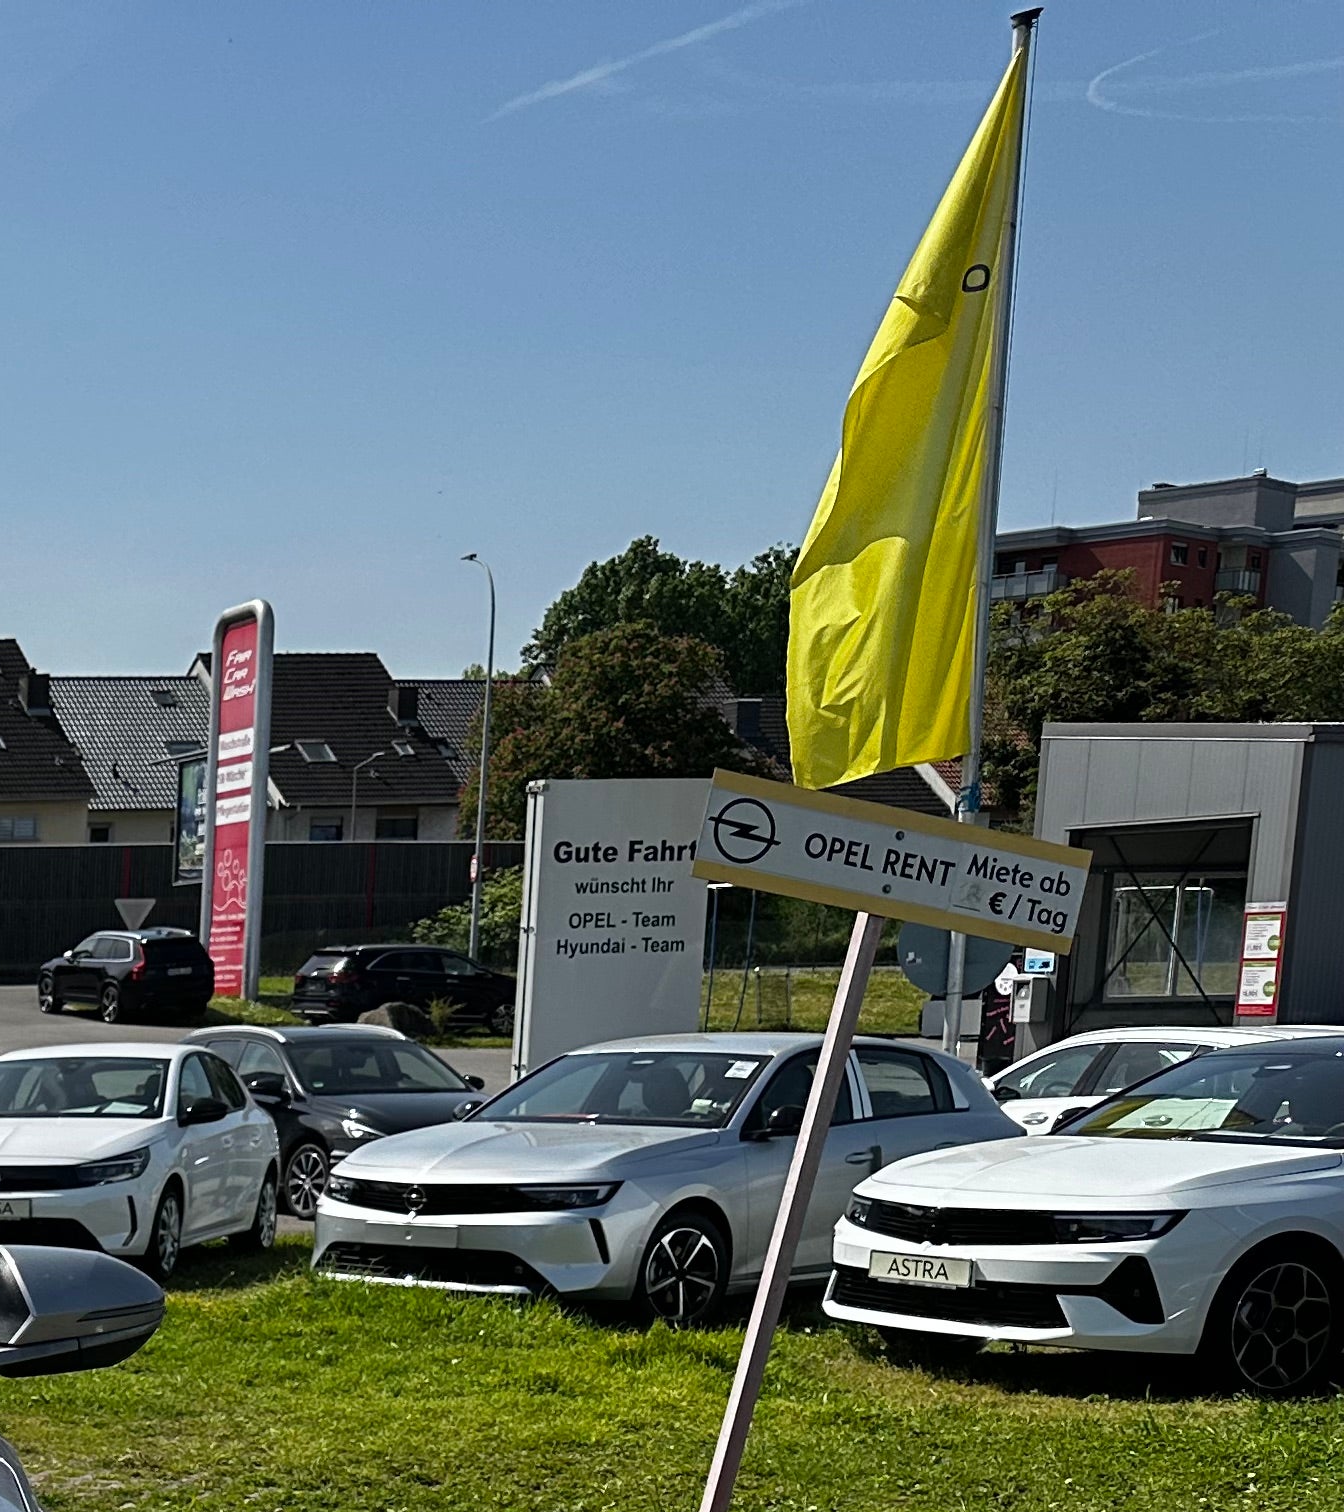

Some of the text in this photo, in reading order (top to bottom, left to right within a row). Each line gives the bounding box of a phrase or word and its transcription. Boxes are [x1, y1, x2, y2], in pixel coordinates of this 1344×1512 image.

[553, 839, 697, 864] Gute Fahrt
[804, 832, 956, 887] OPEL RENT
[574, 876, 675, 895] wünscht Ihr
[966, 853, 1071, 897] Miete ab
[568, 911, 617, 929] OPEL
[631, 911, 676, 928] Team
[1026, 897, 1069, 935] Tag
[556, 936, 626, 959] Hyundai
[641, 936, 685, 953] Team
[886, 1257, 949, 1281] ASTRA
